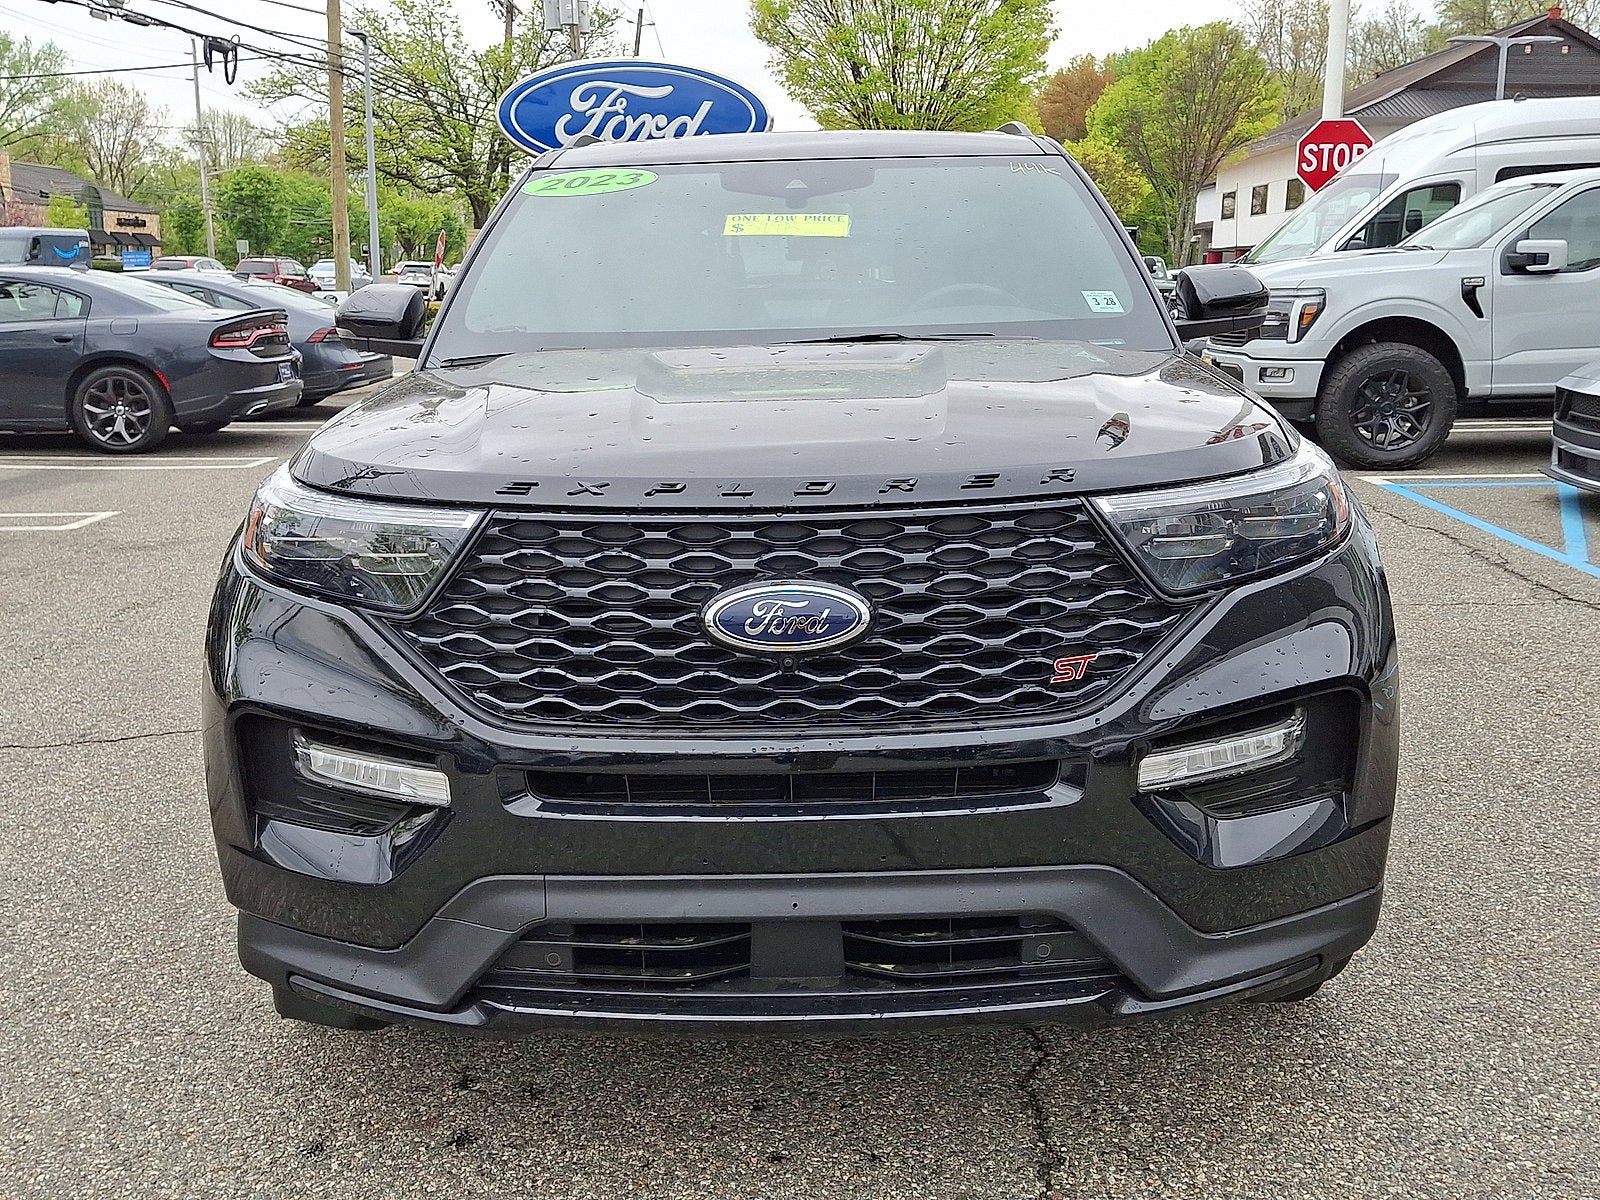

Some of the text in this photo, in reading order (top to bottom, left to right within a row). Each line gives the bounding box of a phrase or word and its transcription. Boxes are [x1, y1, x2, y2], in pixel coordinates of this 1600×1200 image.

[555, 81, 714, 147] Ford
[535, 173, 644, 192] 2023
[804, 215, 845, 223] PRICE
[1091, 297, 1117, 306] 3 28
[495, 467, 1077, 497] EXPLORER
[744, 599, 831, 635] Ford
[1050, 653, 1098, 683] ST
